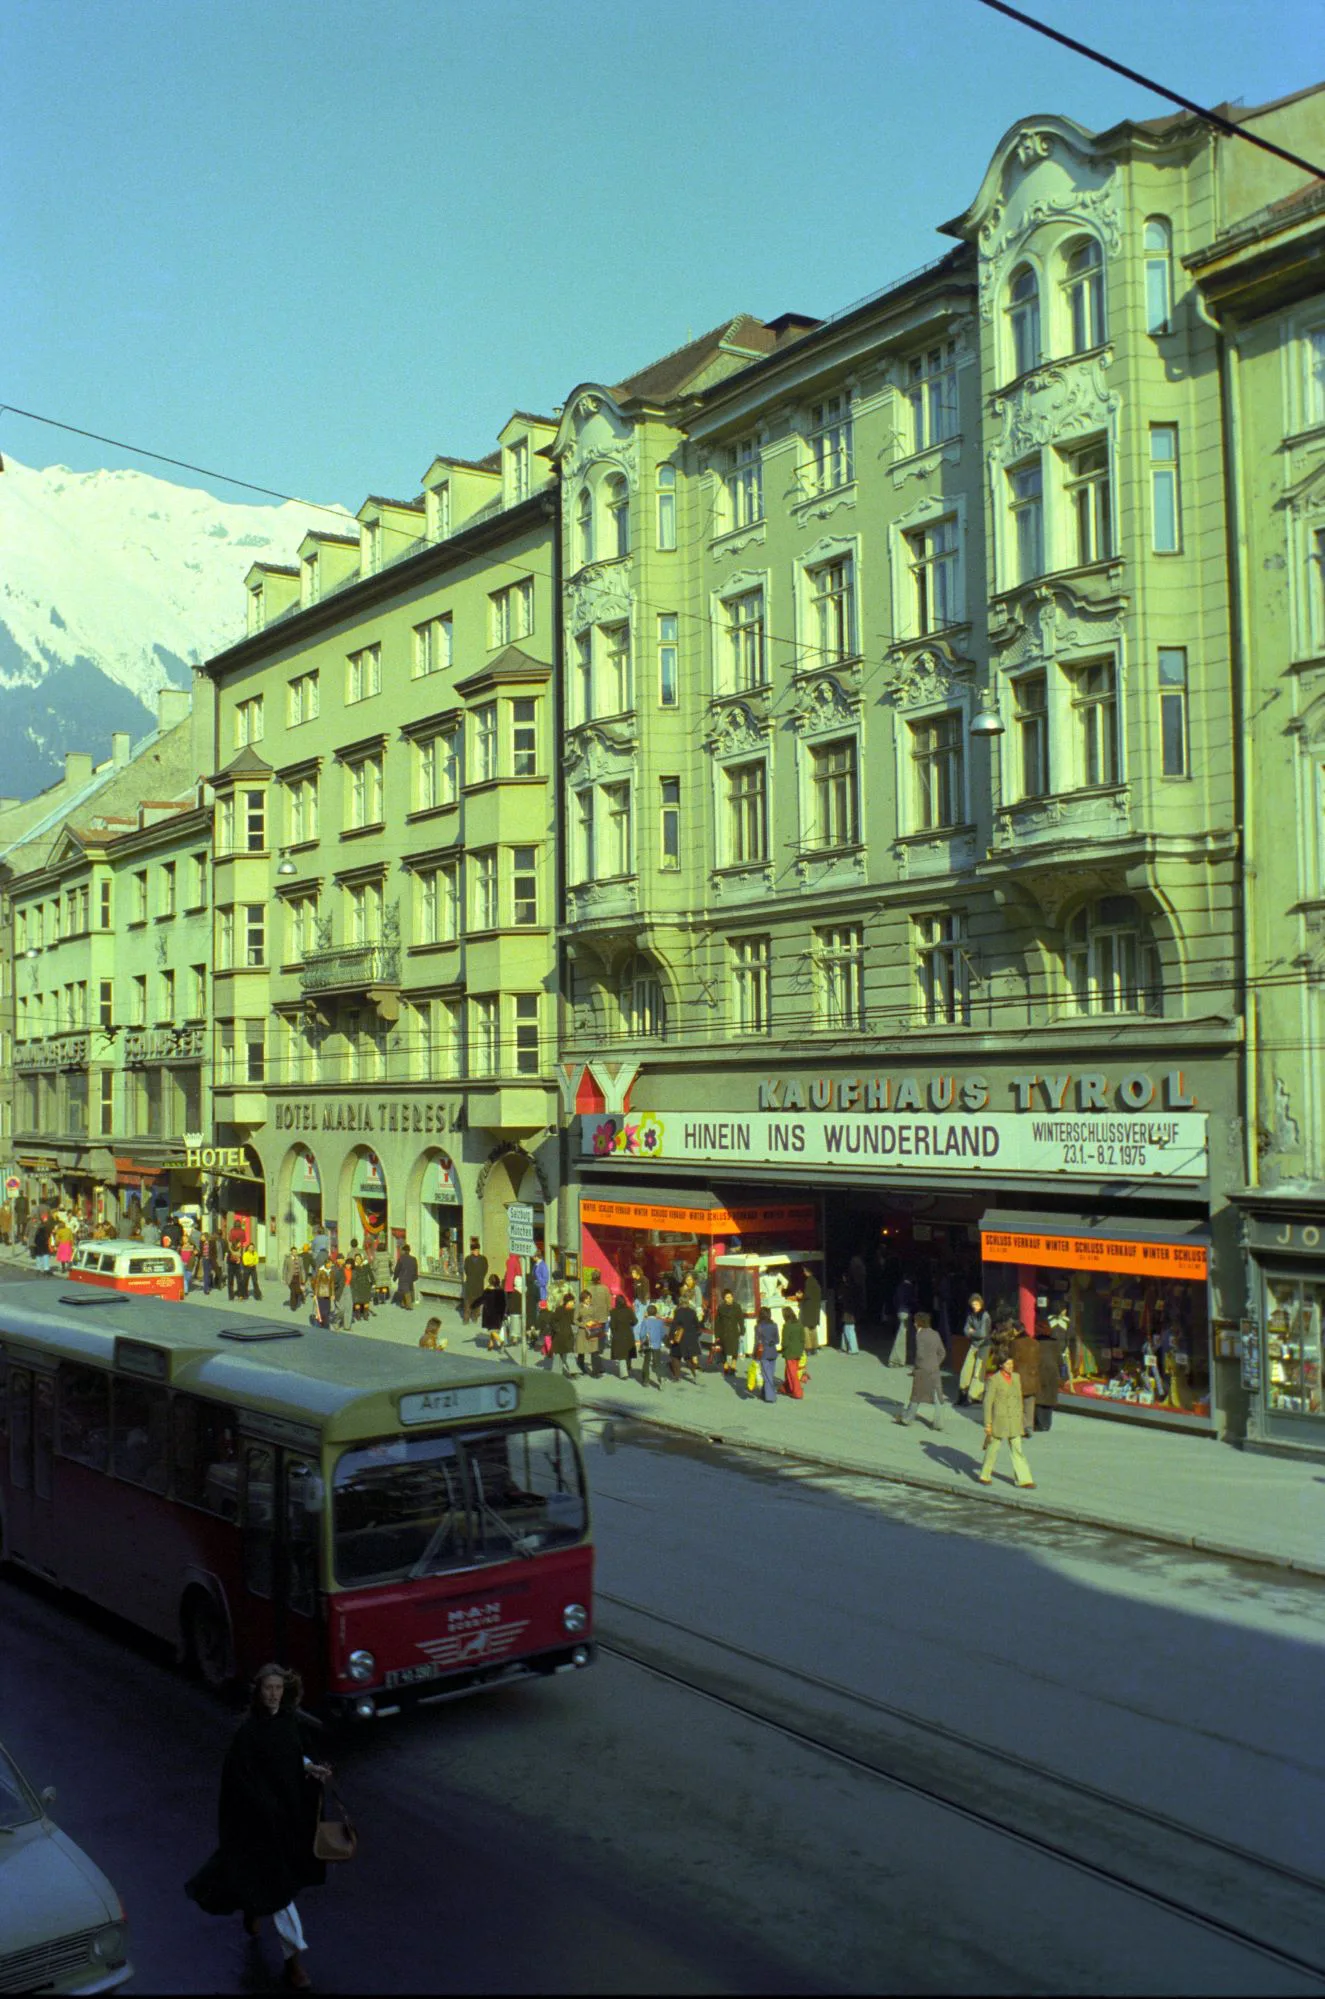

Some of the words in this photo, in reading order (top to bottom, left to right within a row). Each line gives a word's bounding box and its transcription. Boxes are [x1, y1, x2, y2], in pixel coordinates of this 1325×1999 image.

[760, 1075, 990, 1112] KAUFHAUS
[1010, 1071, 1198, 1112] TYROL
[276, 1103, 317, 1130] HOTEL
[322, 1103, 374, 1131] MARIA
[685, 1123, 750, 1150] HINEIN
[768, 1123, 805, 1152] INS
[823, 1123, 999, 1157] WUNDERLAND
[187, 1147, 250, 1168] HOTEL
[985, 1235, 1011, 1246] SCHLUSS
[1013, 1236, 1040, 1249] VERKAUF
[1045, 1240, 1069, 1252] WINTER
[1074, 1241, 1104, 1254] SCHLUSS
[1106, 1244, 1136, 1257] VERKAUF
[1143, 1247, 1169, 1260] WINTER
[1173, 1249, 1206, 1262] SCHLUSS
[495, 1385, 512, 1409] C
